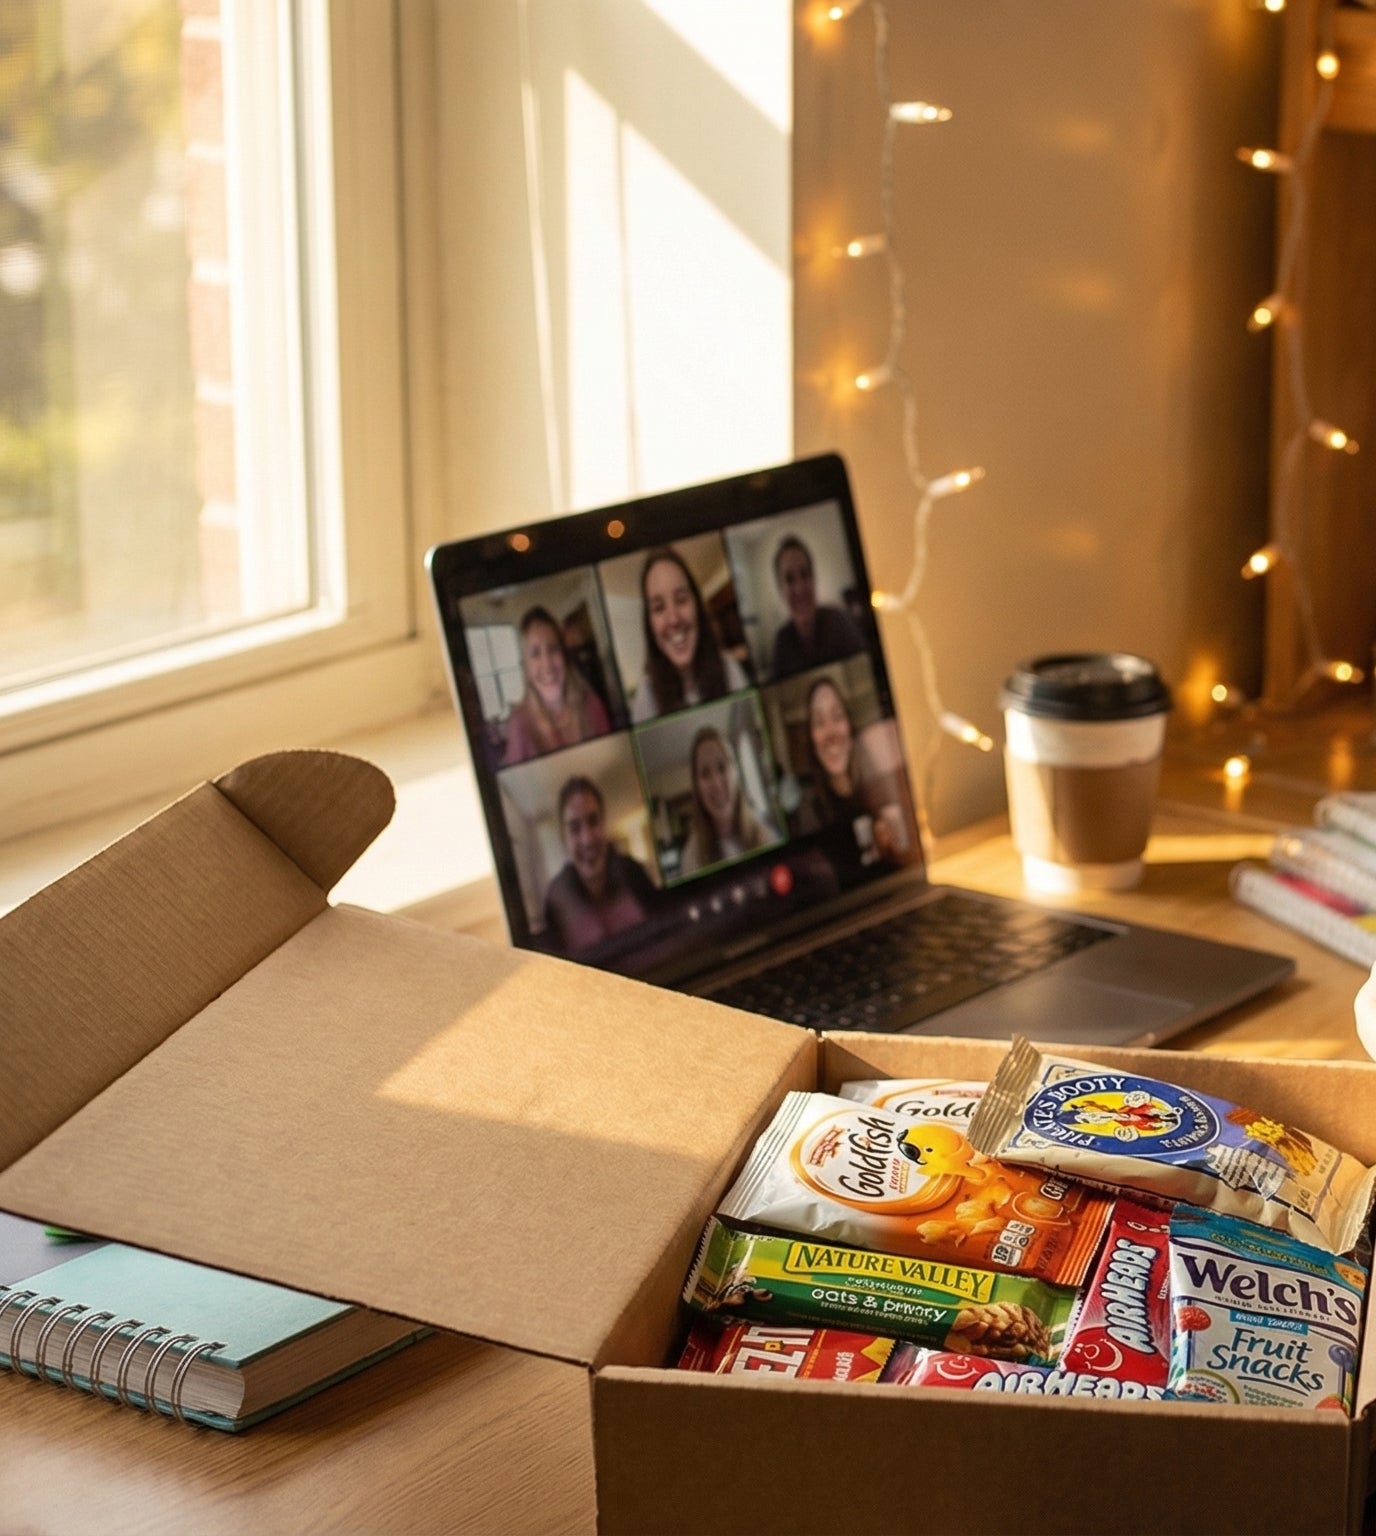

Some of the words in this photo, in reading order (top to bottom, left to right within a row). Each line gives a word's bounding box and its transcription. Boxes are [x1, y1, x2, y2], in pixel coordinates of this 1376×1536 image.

[895, 1100, 977, 1118] Gold
[1053, 1076, 1126, 1102] BOOTY
[838, 1117, 895, 1197] Goldfish
[794, 1244, 894, 1274] NATURE
[899, 1260, 989, 1300] VALLEY
[1101, 1237, 1157, 1354] AIRHEADS
[1177, 1252, 1358, 1327] Welch's
[811, 1287, 858, 1306] oats
[862, 1295, 879, 1309] &
[1206, 1344, 1325, 1393] Snacks
[1230, 1327, 1313, 1364] Fruit
